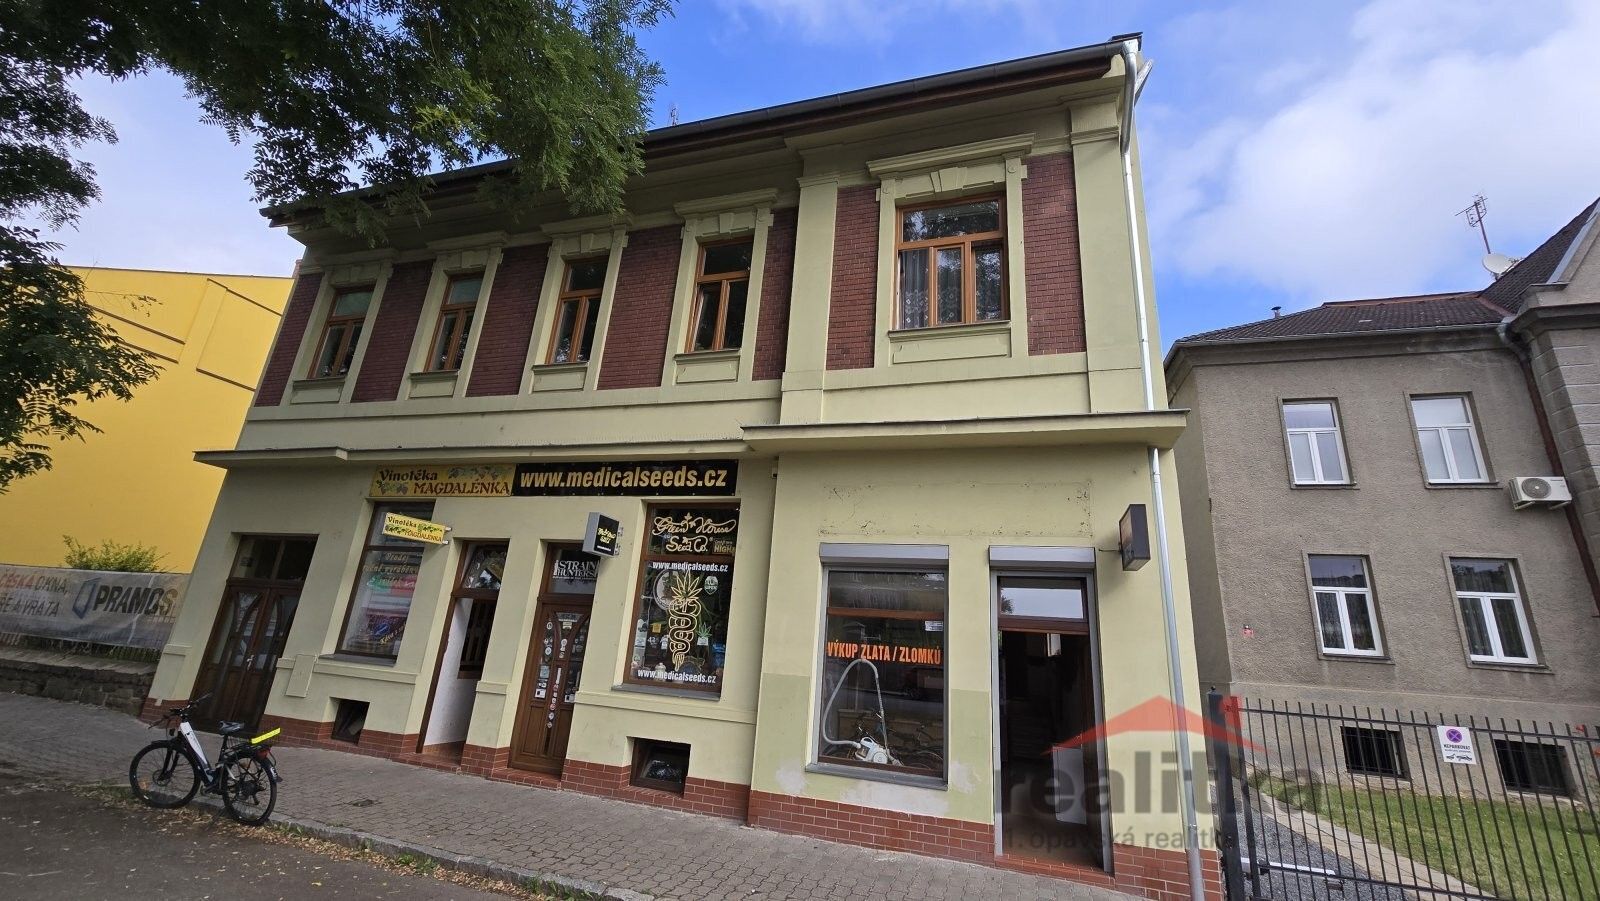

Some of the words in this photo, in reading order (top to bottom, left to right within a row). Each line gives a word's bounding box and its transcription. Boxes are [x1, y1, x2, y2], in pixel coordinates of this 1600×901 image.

[379, 468, 438, 482] Vinotéka
[520, 466, 728, 488] www.medicalseeds.cz
[413, 479, 510, 496] MAGDALÉNKA
[387, 516, 417, 528] Vinotéka
[652, 516, 689, 536] Green
[691, 516, 737, 534] House
[665, 535, 693, 552] Seed
[559, 560, 597, 571] STRAIN
[652, 561, 729, 573] www.medicalseeds.cz
[93, 585, 178, 615] PRAMOS
[827, 639, 858, 658] VÝKUP
[860, 644, 891, 661] ZLATA
[892, 646, 898, 662] /
[637, 669, 717, 684] www.medicalseeds.cz
